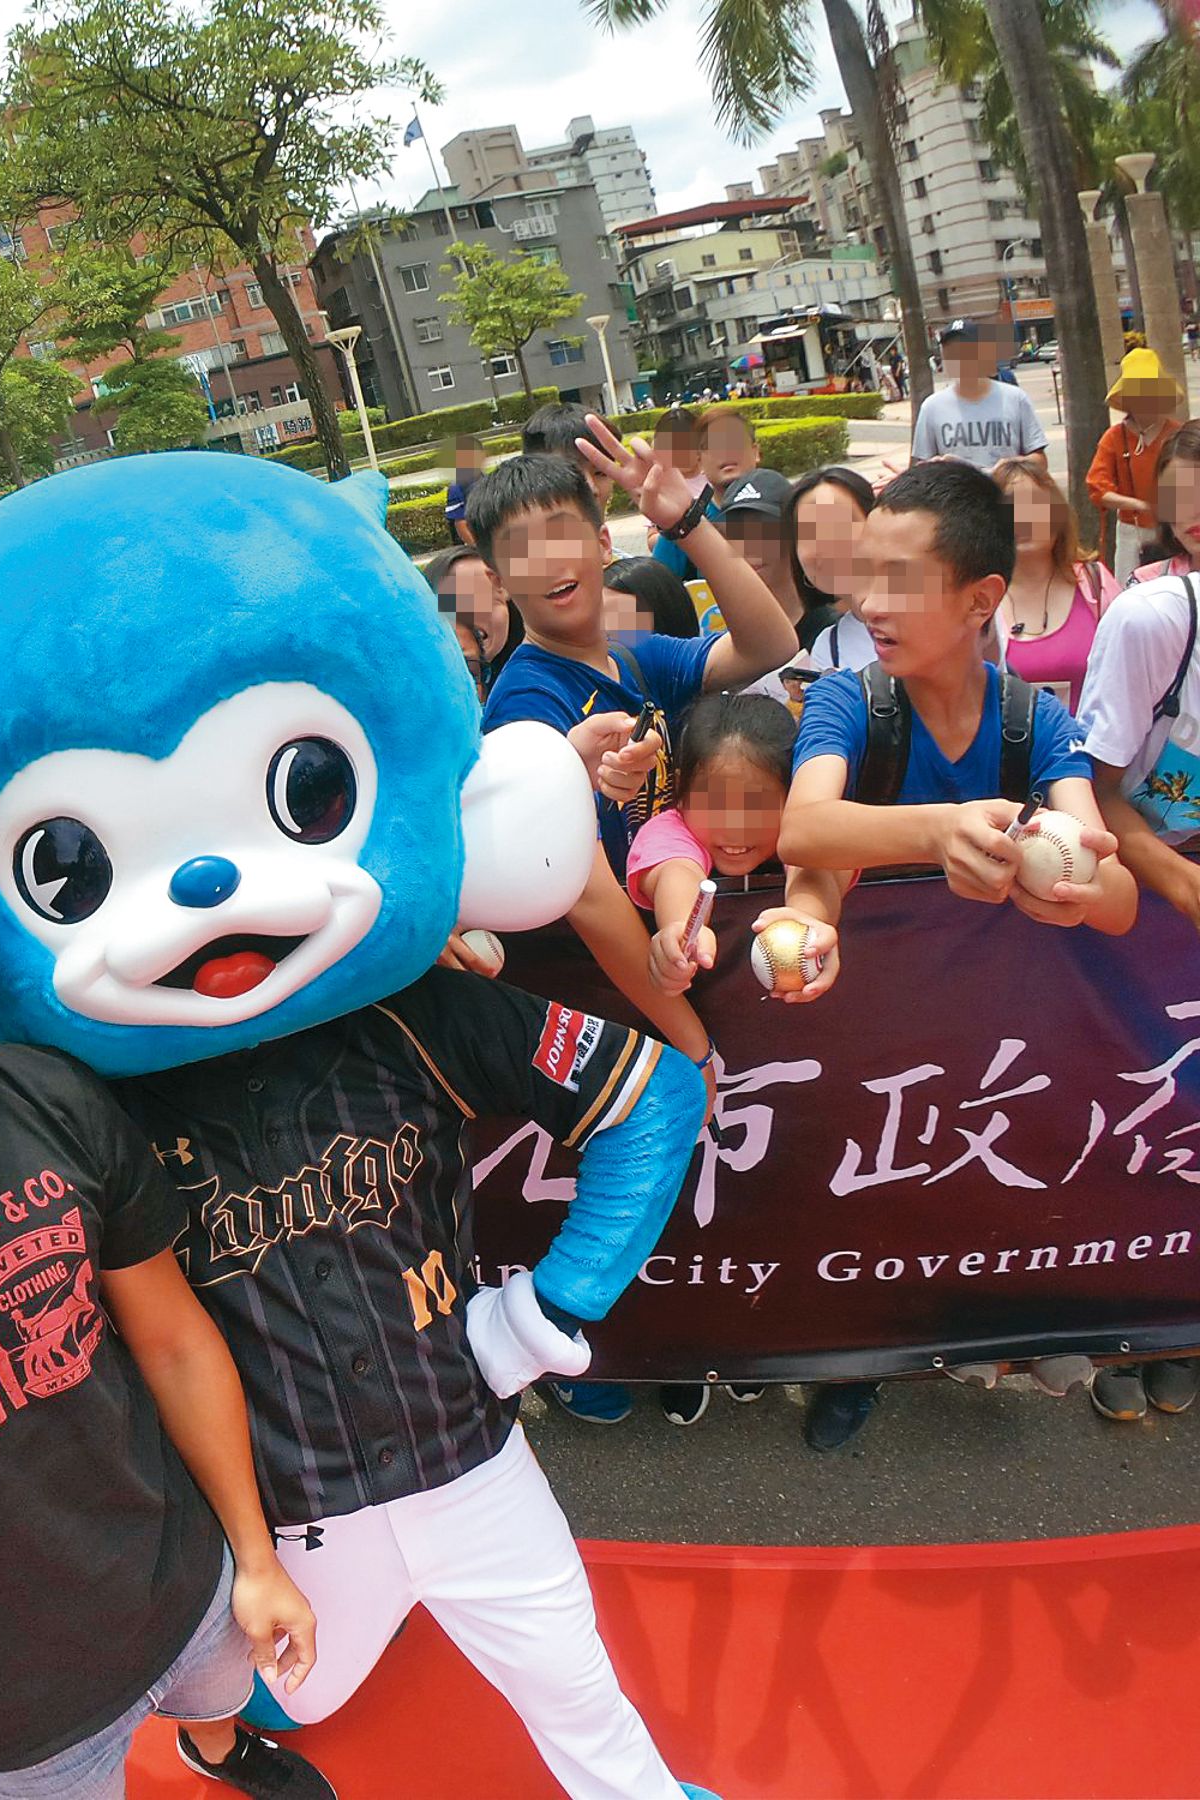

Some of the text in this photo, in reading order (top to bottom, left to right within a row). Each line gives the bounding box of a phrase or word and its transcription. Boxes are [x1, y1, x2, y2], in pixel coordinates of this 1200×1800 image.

[941, 420, 1012, 448] CALVIN
[0, 1191, 30, 1223] &
[23, 1169, 74, 1208] CO.
[638, 1254, 780, 1293] City
[45, 1371, 76, 1391] MAY
